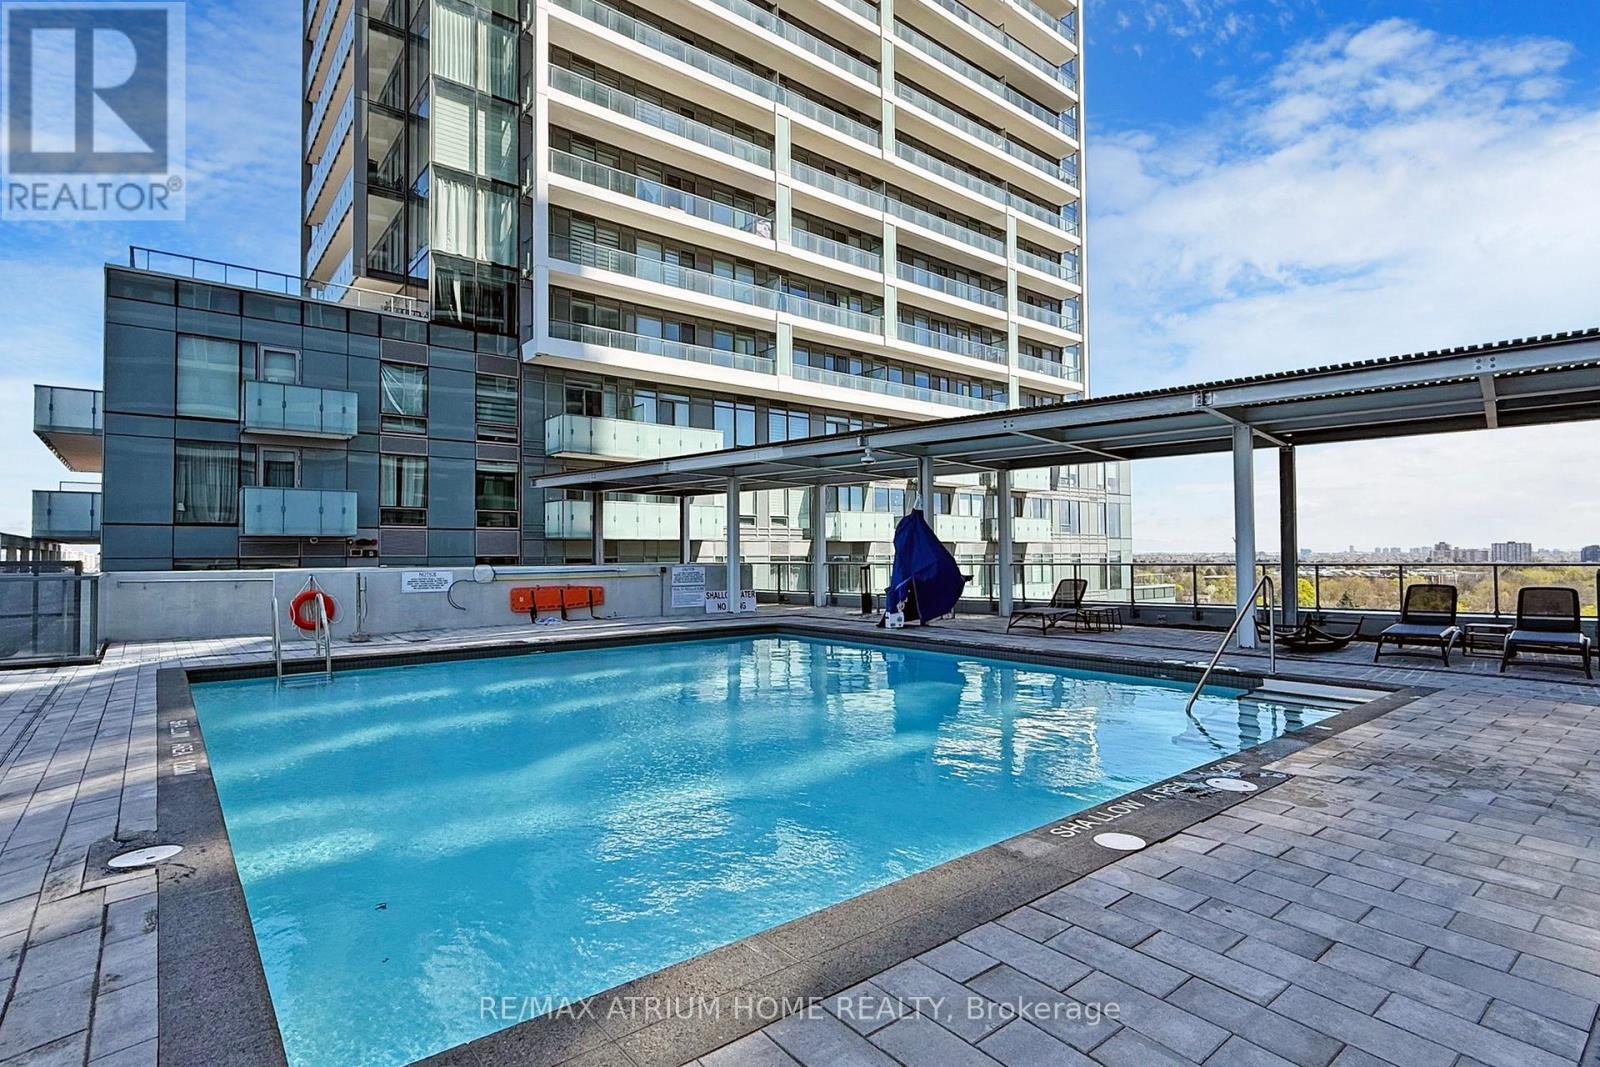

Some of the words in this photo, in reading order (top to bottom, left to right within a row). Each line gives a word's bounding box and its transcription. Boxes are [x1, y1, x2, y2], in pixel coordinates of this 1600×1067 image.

[740, 590, 756, 599] ATER
[717, 602, 727, 611] NO
[1050, 799, 1145, 839] SHALLOW
